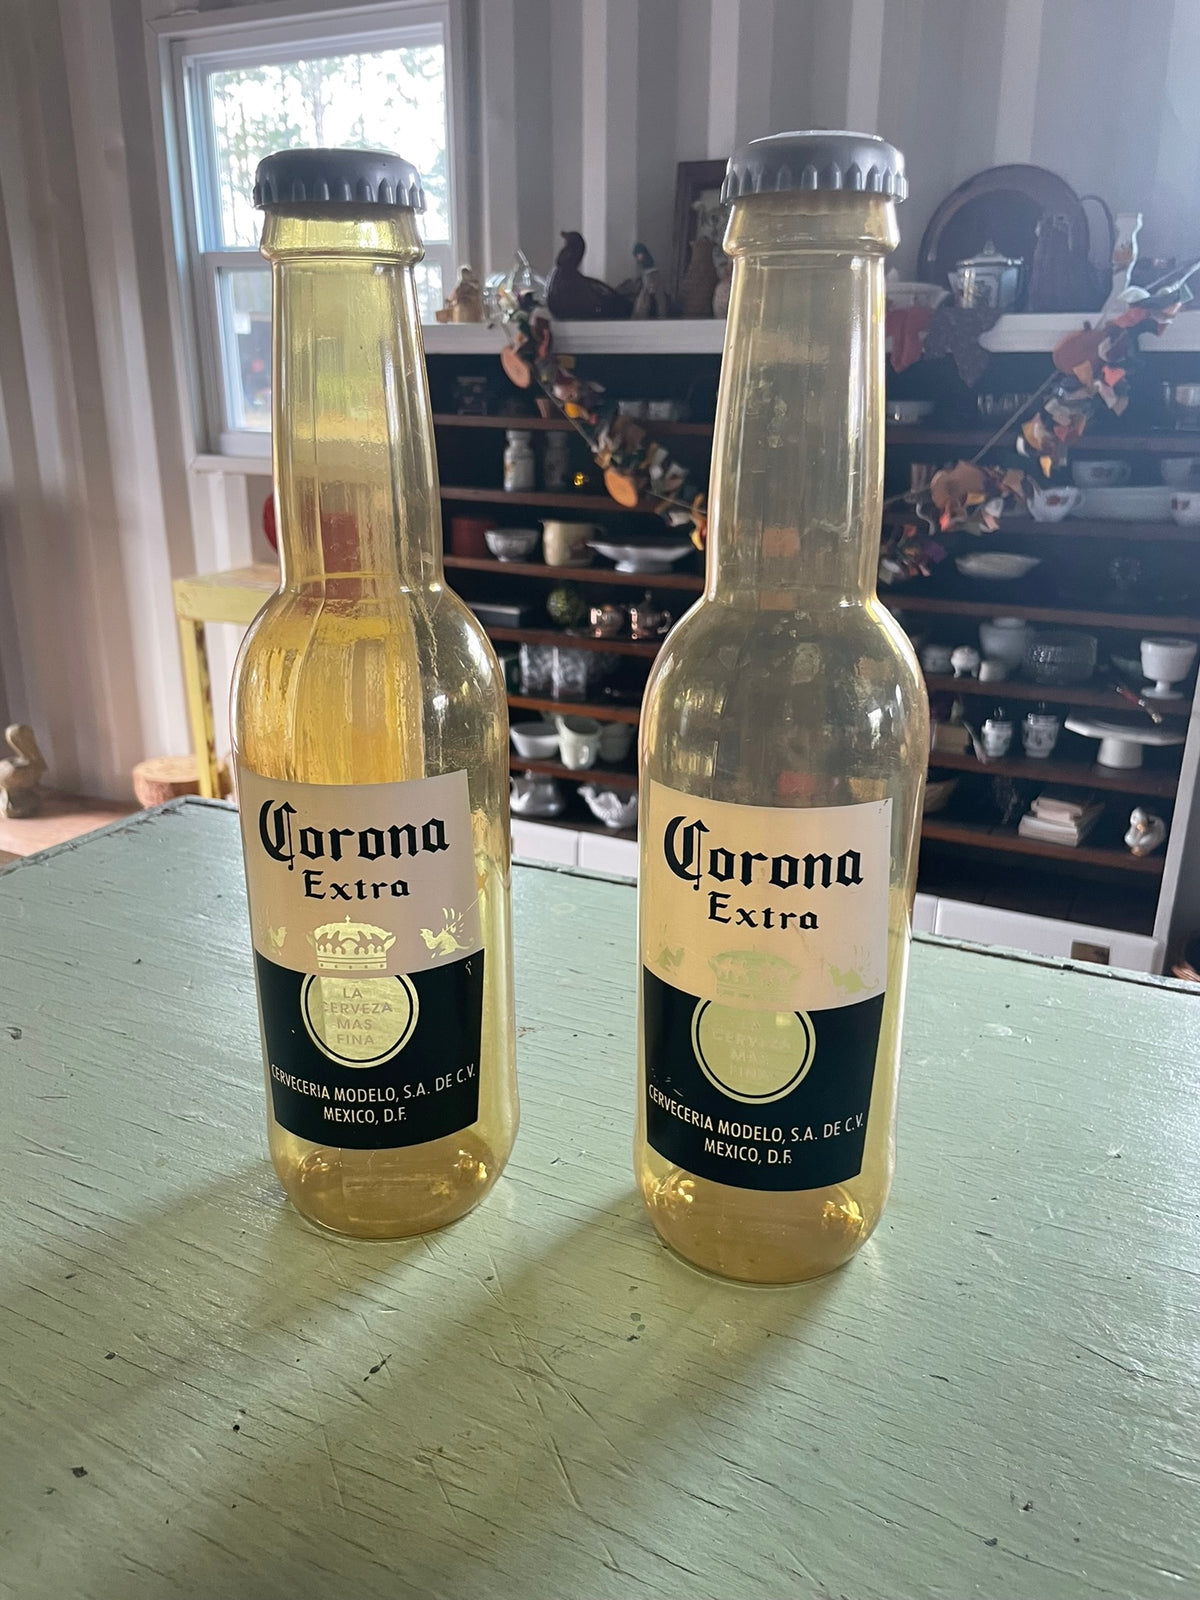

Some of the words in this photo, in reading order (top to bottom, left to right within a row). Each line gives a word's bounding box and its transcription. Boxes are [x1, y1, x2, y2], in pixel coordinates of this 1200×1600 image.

[258, 799, 451, 871] Corona
[663, 815, 864, 891] Corona
[302, 869, 411, 900] Extra
[707, 890, 819, 930] Extra
[321, 1001, 393, 1014] CERVEZA
[343, 987, 363, 999] LA
[337, 1018, 373, 1031] MAS
[337, 1033, 375, 1046] FINA
[271, 1063, 331, 1101] CERVECERIA
[334, 1086, 399, 1103] MODELO,
[403, 1083, 431, 1099] S.A.
[435, 1073, 452, 1092] DE
[456, 1063, 476, 1083] C.V.
[323, 1106, 379, 1126] MEXICO,
[384, 1106, 407, 1123] D.F.
[648, 1083, 714, 1131] CERVECERIA
[717, 1119, 787, 1145] MODELO,
[790, 1127, 818, 1142] S.A.
[823, 1120, 841, 1139] DE
[845, 1112, 864, 1133] C.V.
[704, 1137, 762, 1165] MEXICO,
[767, 1149, 793, 1165] D.F.
